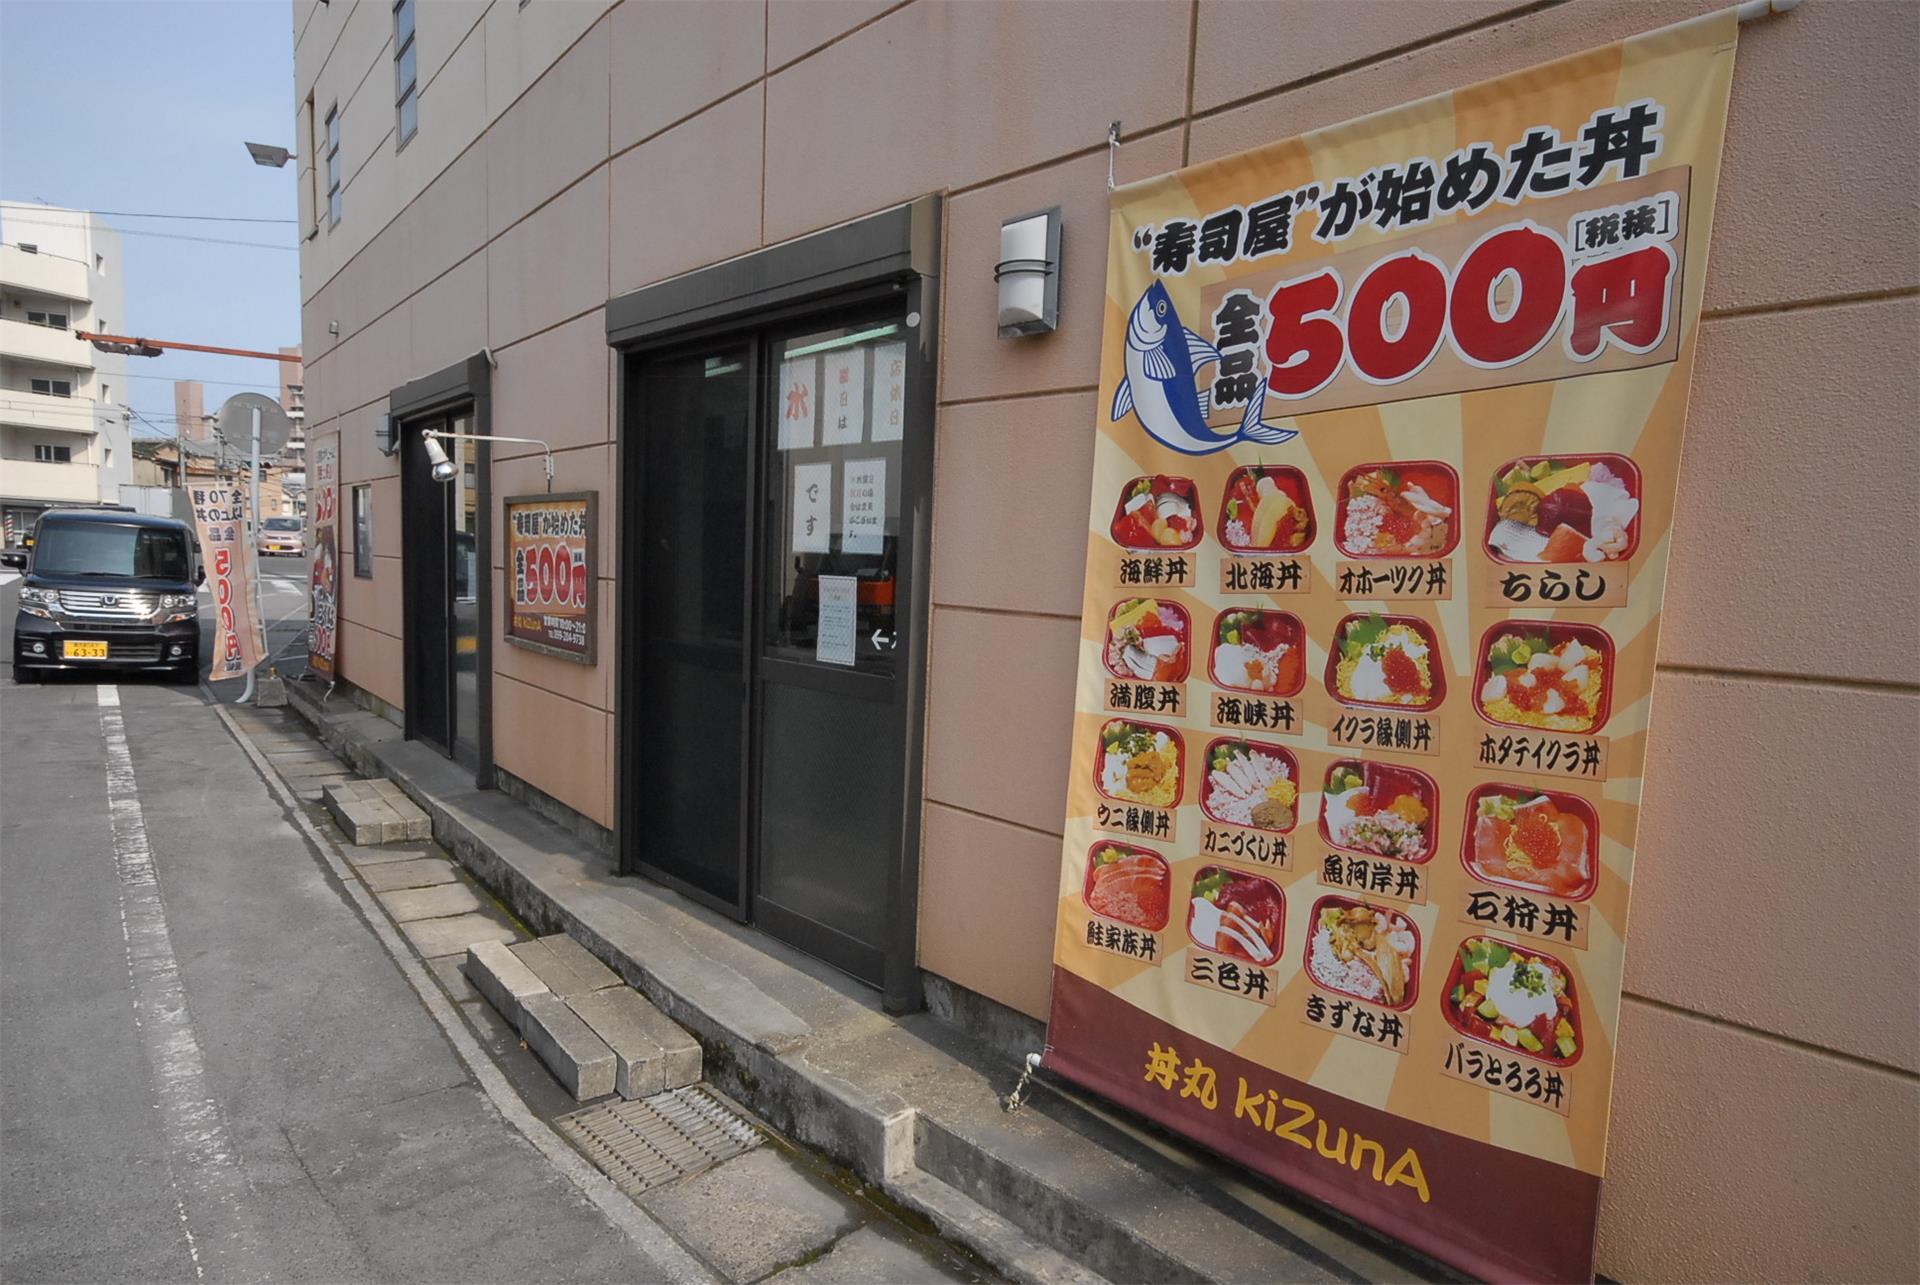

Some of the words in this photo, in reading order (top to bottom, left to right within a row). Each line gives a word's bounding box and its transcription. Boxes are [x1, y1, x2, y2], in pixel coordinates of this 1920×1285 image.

[1266, 227, 1671, 396] 500円
[1215, 295, 1260, 404] 全品
[785, 382, 808, 421] 水
[806, 483, 818, 537] です
[1120, 556, 1188, 584] 海鮮丼
[1225, 558, 1303, 591] 北海丼
[1339, 562, 1446, 596] オホーツク丼
[1500, 569, 1606, 602] ちらし
[1110, 683, 1180, 713] 満腹丼
[1217, 697, 1295, 730] 海峡丼
[1332, 717, 1432, 752] イクラ縁側丼
[1480, 737, 1600, 775] ホタテイクラ丼
[1097, 805, 1170, 838] ウニ縁側丼
[1204, 829, 1287, 867] カニづくし丼
[1323, 855, 1420, 899] 魚河岸丼
[1466, 891, 1578, 940] 石狩丼
[1086, 921, 1157, 961] 鮭家族丼
[1191, 957, 1269, 999] 三色丼
[1306, 994, 1403, 1044] きずな丼
[1143, 1042, 1217, 1109] 丼丸
[1445, 1042, 1564, 1107] バラとろろ丼
